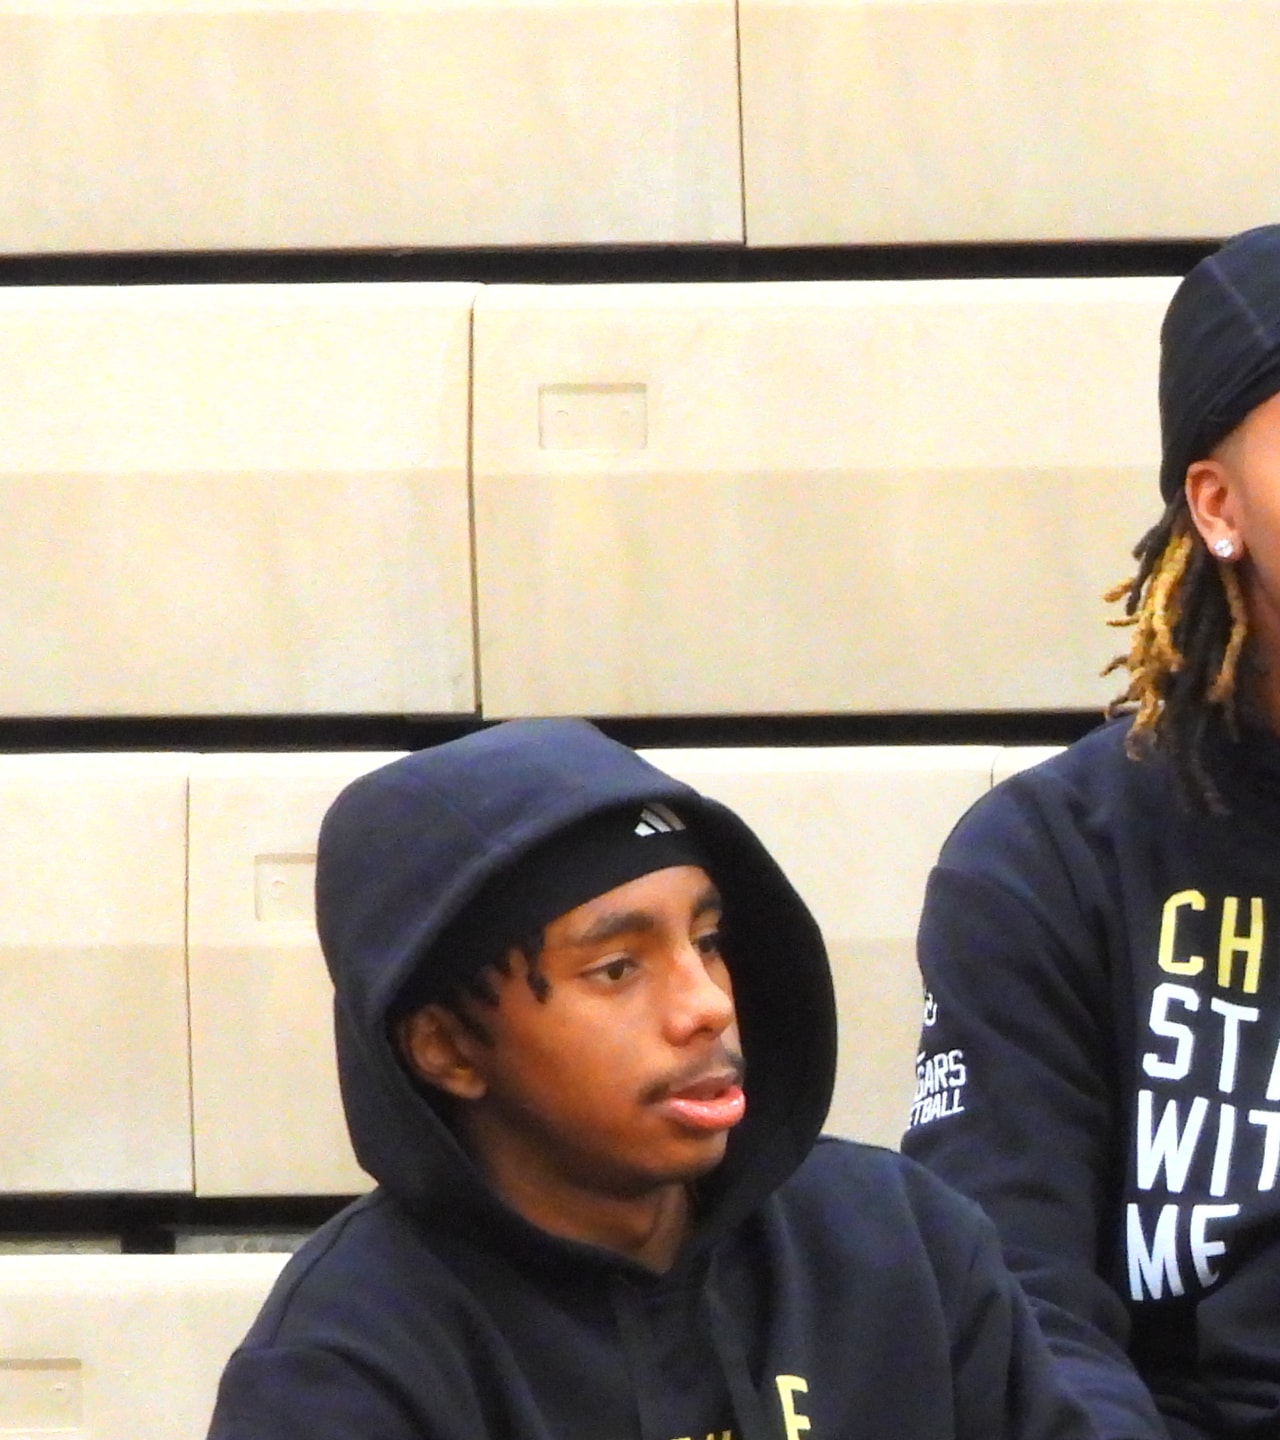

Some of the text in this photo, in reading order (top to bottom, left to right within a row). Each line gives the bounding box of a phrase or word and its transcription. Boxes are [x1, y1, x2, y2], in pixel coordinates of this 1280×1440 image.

[914, 1049, 966, 1101] GARS
[907, 1088, 964, 1130] TBALL
[1125, 1203, 1239, 1301] ME
